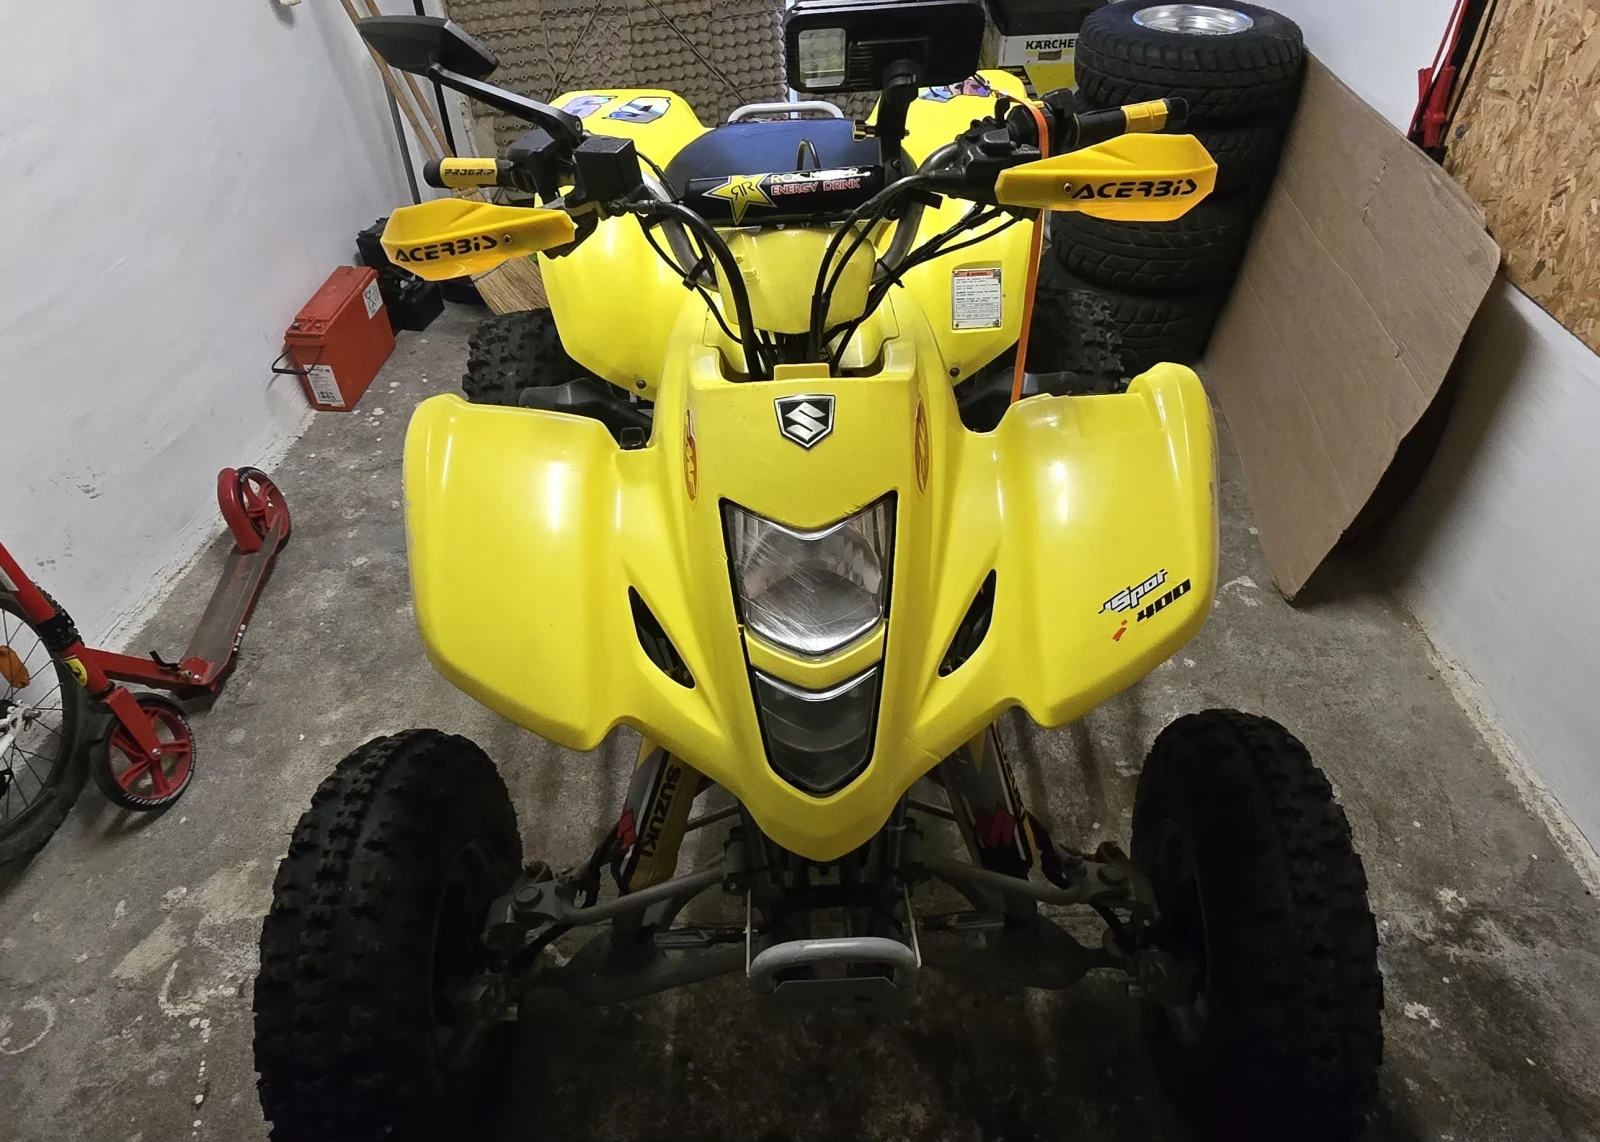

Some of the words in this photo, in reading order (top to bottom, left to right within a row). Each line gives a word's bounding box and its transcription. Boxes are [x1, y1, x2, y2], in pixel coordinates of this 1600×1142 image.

[1025, 38, 1076, 50] KÄRCHE
[770, 181, 819, 196] ENERGY
[822, 177, 861, 192] DRINK
[1136, 578, 1192, 623] 400
[639, 764, 682, 858] SUZUKI
